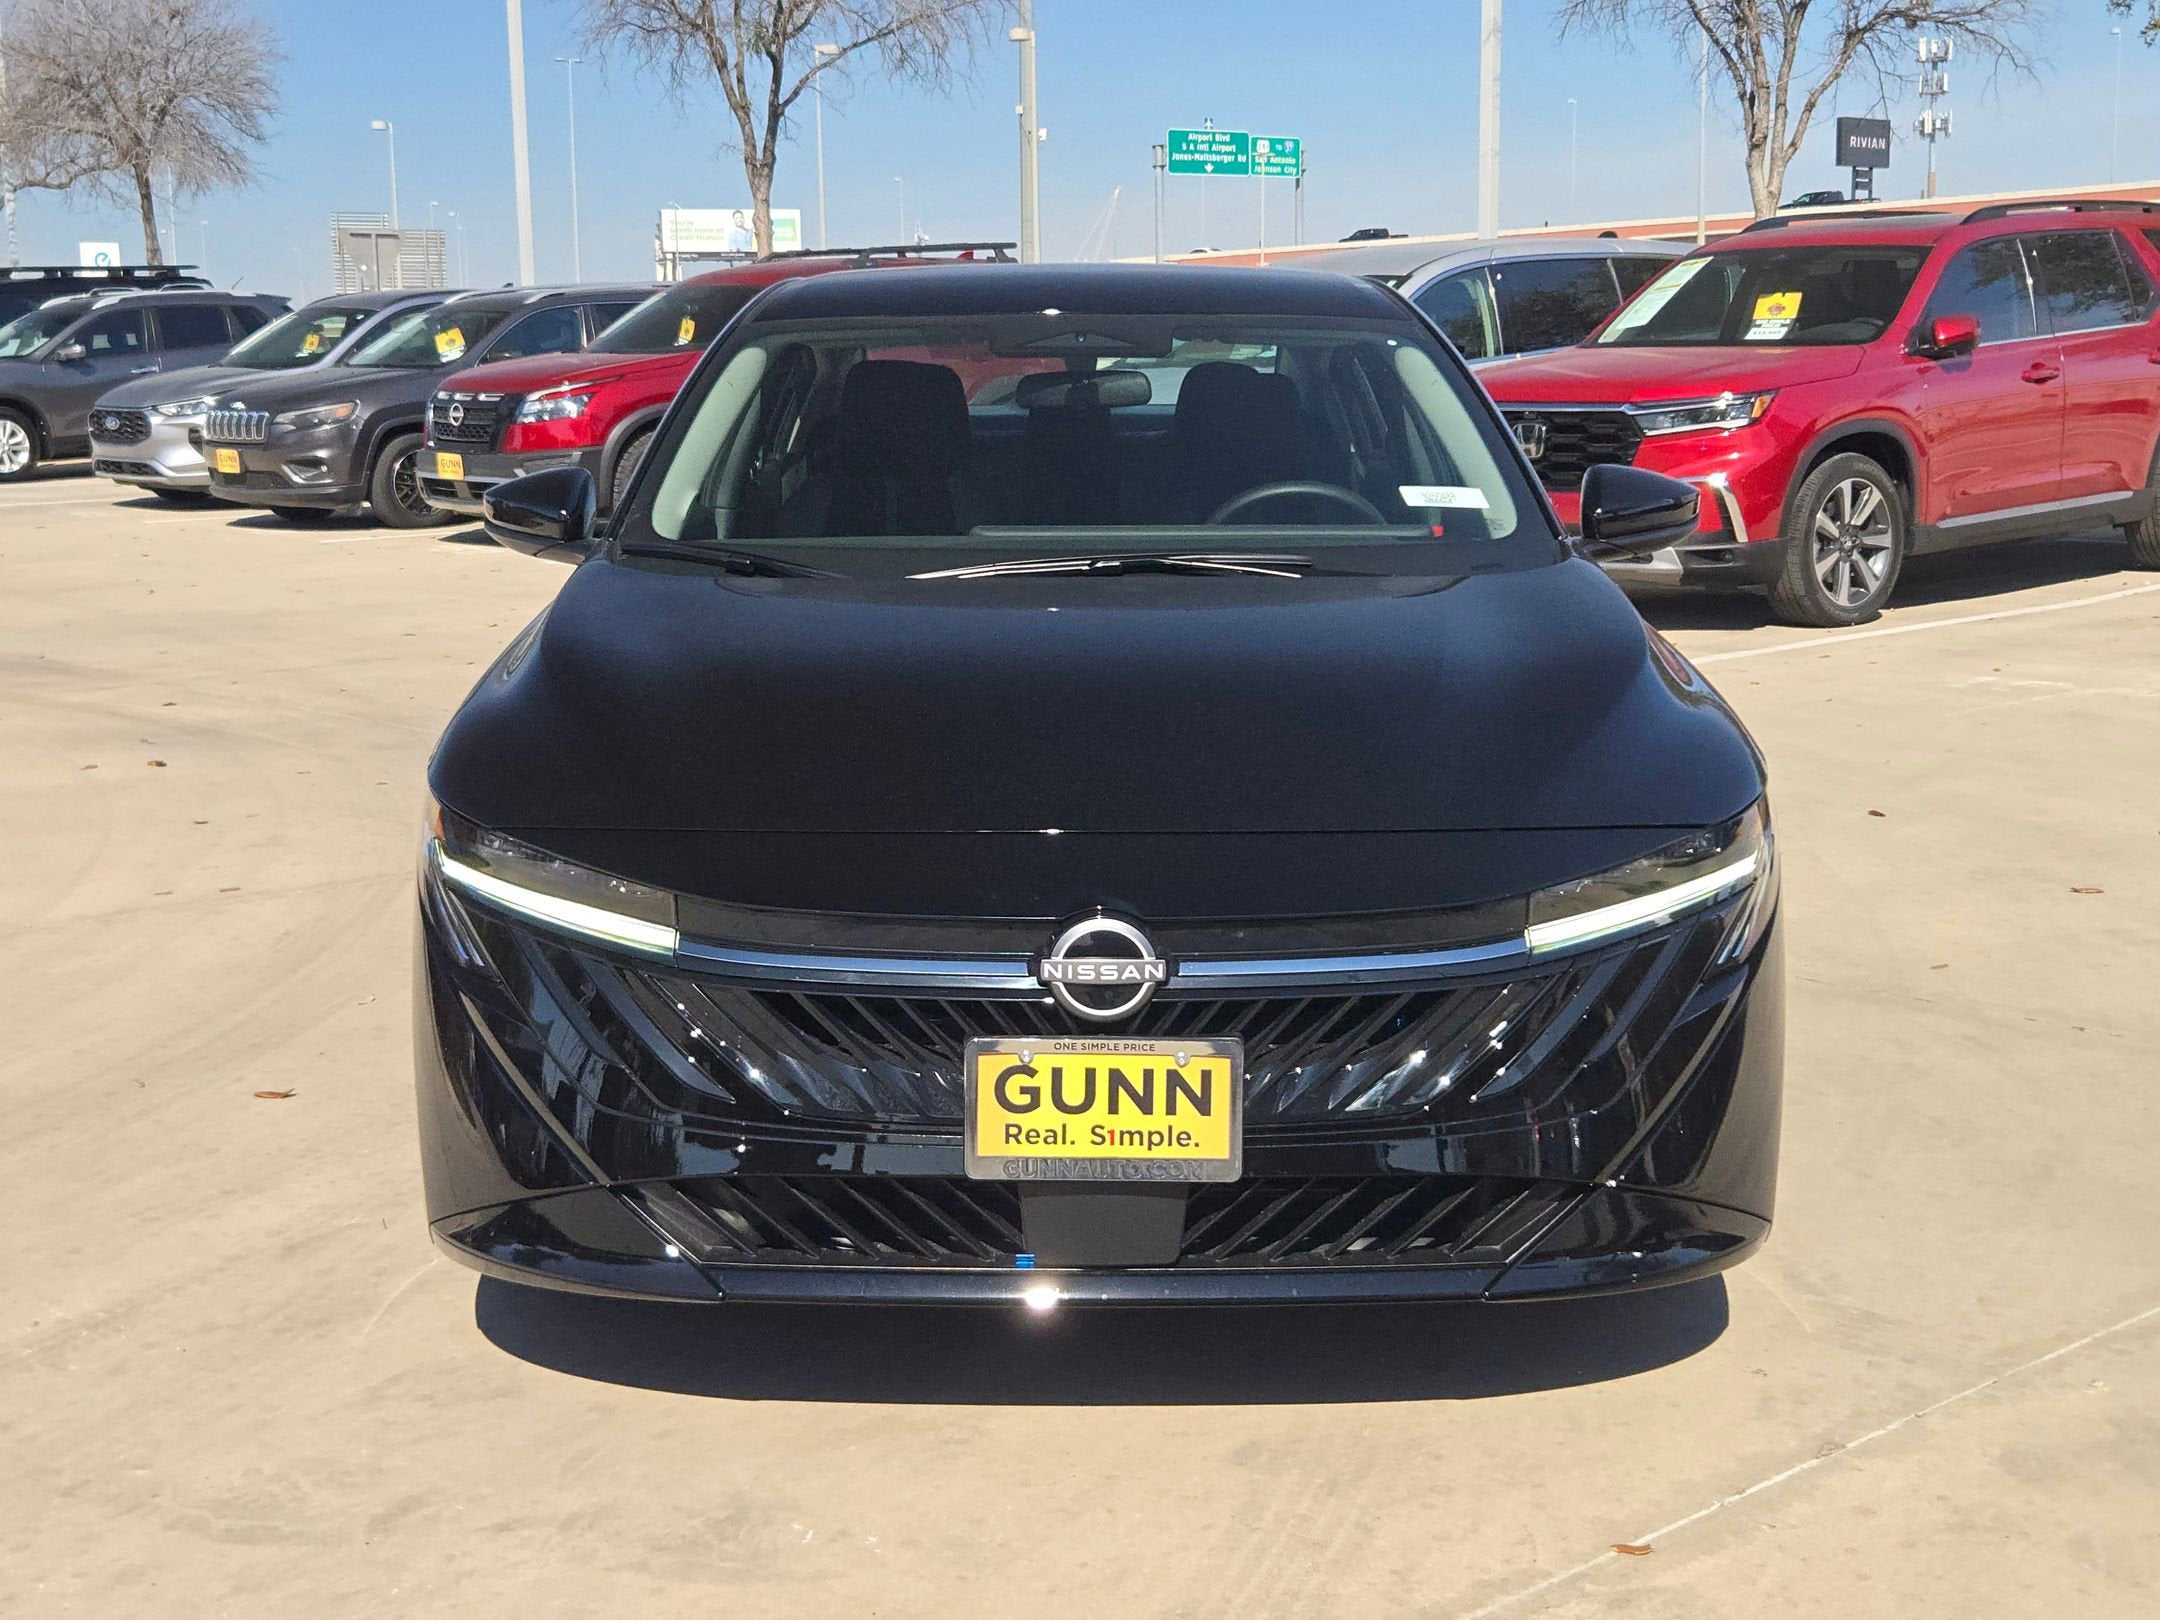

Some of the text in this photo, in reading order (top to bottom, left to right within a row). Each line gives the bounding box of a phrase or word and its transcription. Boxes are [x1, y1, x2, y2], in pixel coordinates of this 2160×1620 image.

[1188, 133, 1231, 142] Airport Blvd
[1850, 136, 1886, 149] RIVIAN
[1211, 144, 1236, 153] Airport
[1172, 153, 1235, 163] Jones-Maltsberger
[1270, 156, 1296, 165] Antonio
[1283, 165, 1297, 176] City
[440, 458, 463, 470] GUNN
[1043, 963, 1164, 980] NISSAN
[1053, 1042, 1156, 1052] ONE SIMPLE PRICE
[994, 1065, 1212, 1117] GUNN
[1004, 1123, 1076, 1146] Real.
